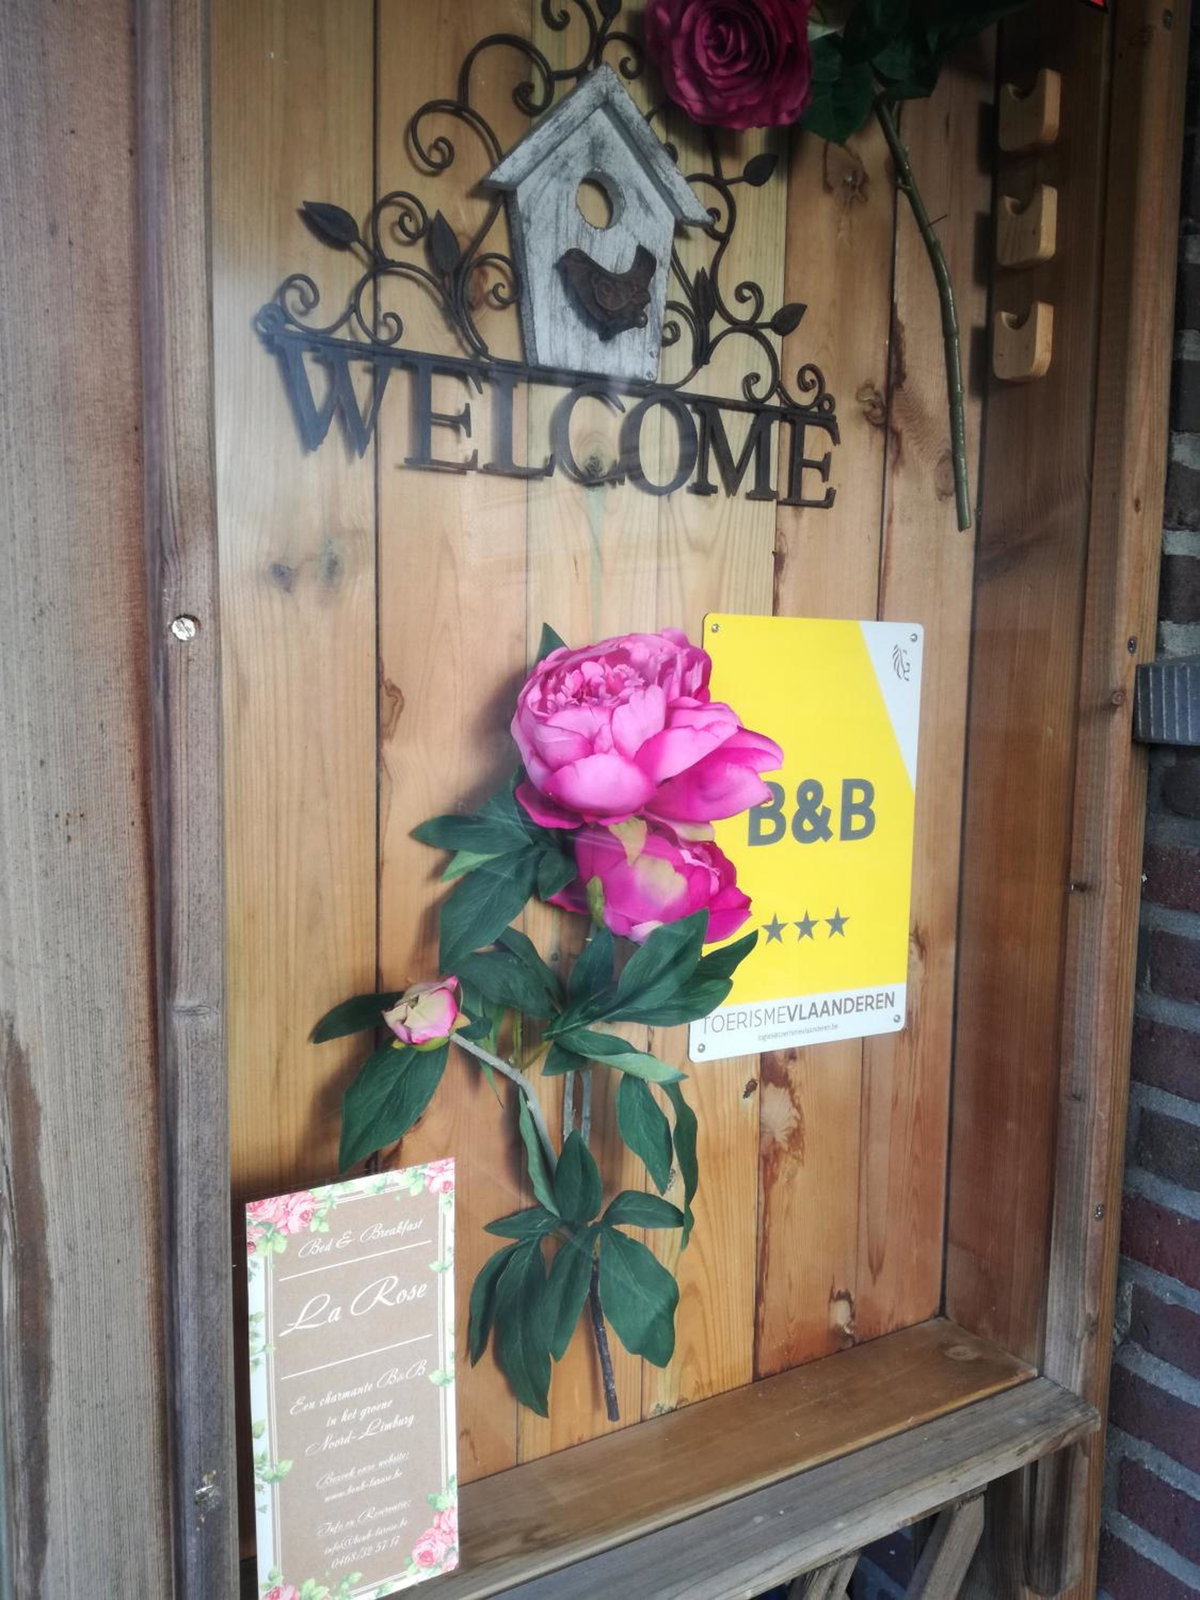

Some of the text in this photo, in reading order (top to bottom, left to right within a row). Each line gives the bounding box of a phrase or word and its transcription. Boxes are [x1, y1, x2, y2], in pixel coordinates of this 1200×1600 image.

[274, 335, 840, 508] WELCOME
[747, 777, 876, 847] B&B
[298, 1238, 333, 1258] Bed
[360, 1218, 424, 1244] Breakfast
[278, 1275, 428, 1338] La Rose
[289, 1395, 316, 1416] Een
[319, 1382, 374, 1408] charmante
[326, 1400, 393, 1428] in het groene
